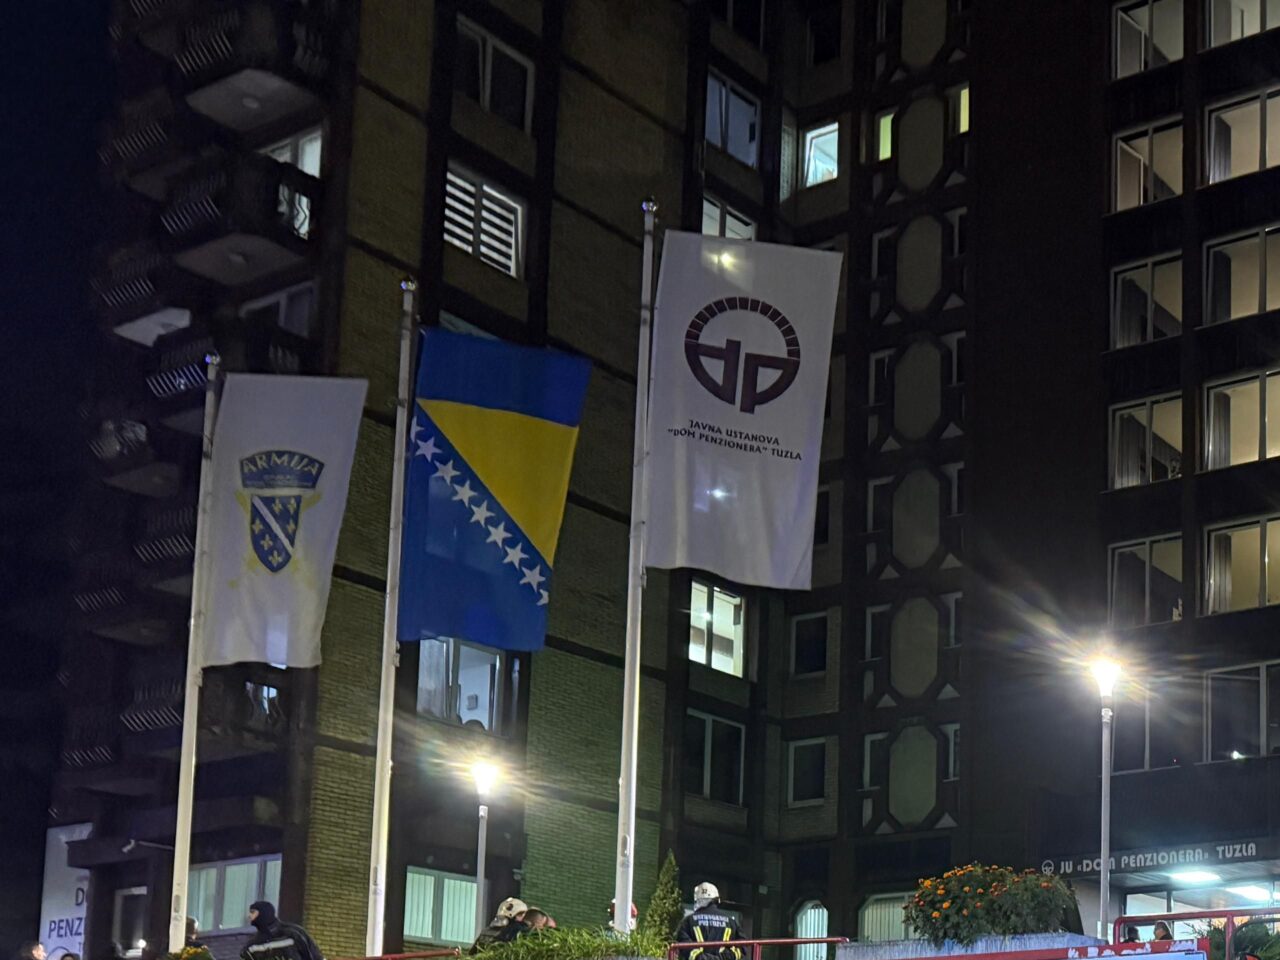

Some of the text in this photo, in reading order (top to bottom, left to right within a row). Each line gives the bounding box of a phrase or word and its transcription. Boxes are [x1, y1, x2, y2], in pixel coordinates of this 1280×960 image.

[689, 419, 780, 446] JAVNA USTANOVA
[243, 452, 319, 476] ARMIJA
[771, 448, 802, 461] TUZLA
[1060, 860, 1073, 874] JU
[1216, 842, 1256, 859] TUZLA
